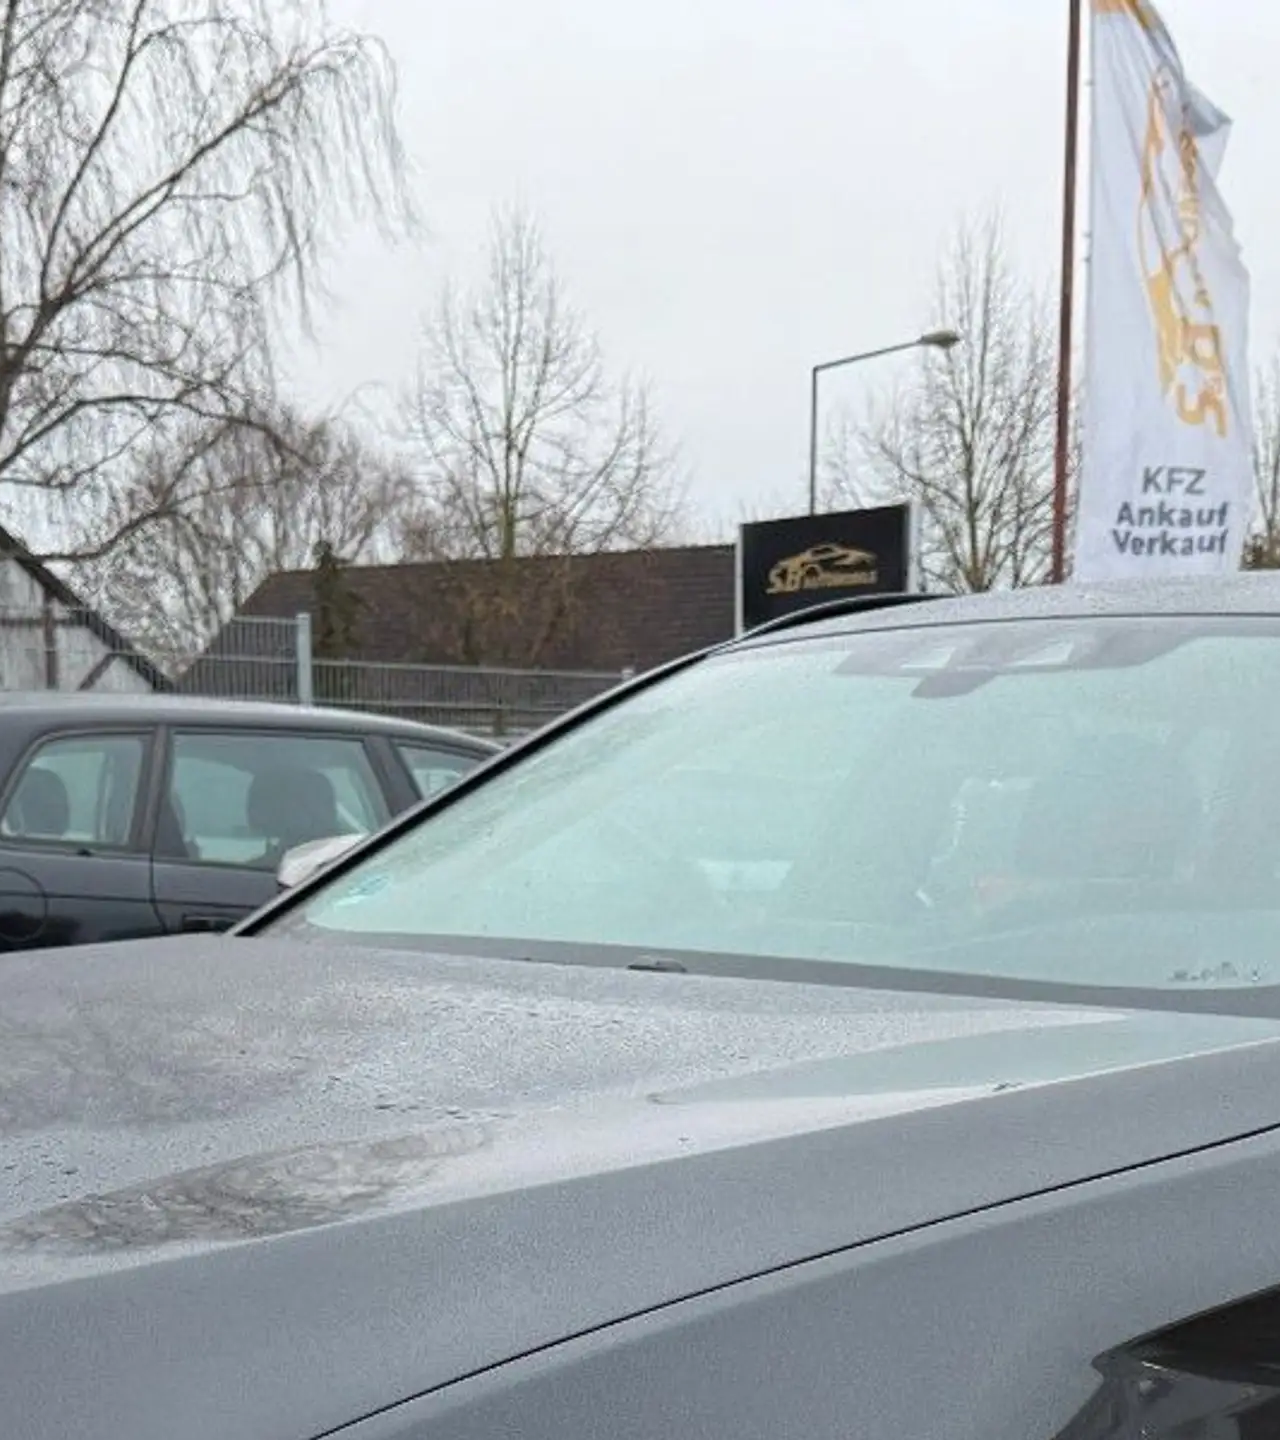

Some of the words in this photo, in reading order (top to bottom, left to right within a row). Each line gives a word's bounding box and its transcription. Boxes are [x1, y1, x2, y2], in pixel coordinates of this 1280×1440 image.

[1141, 466, 1206, 495] KFZ
[1117, 501, 1229, 528] Ankauf
[1112, 528, 1229, 556] Verkauf
